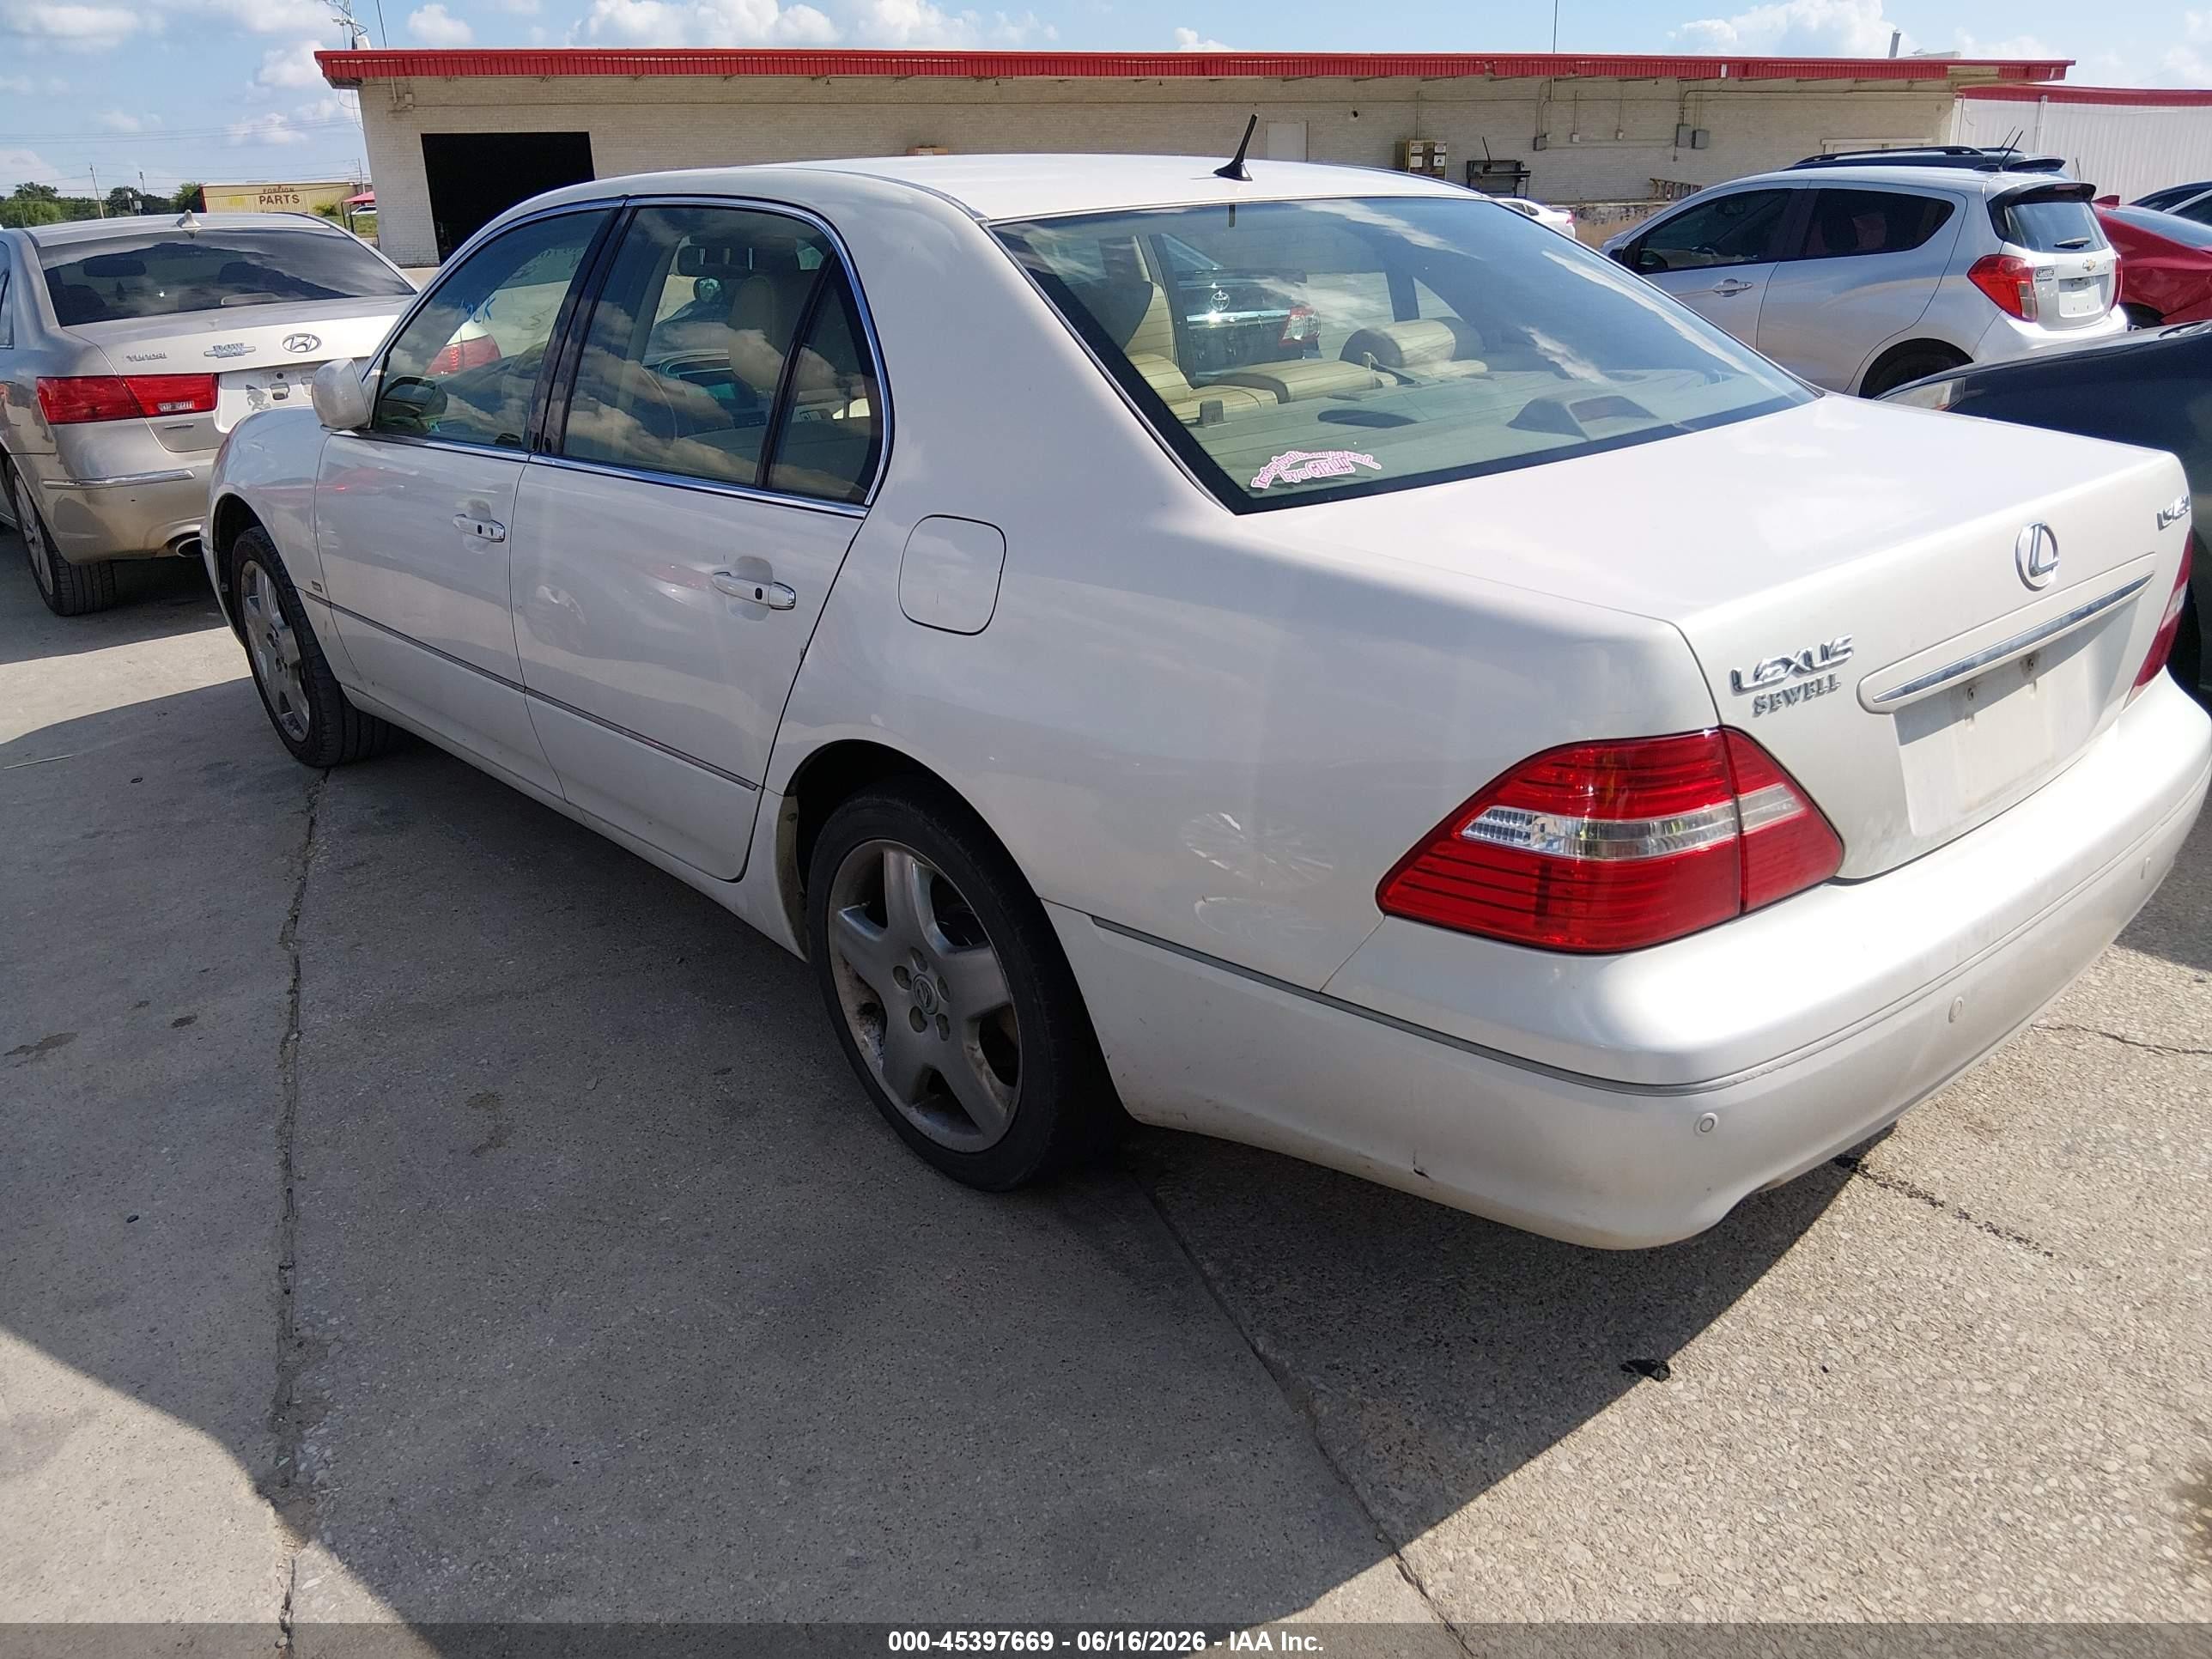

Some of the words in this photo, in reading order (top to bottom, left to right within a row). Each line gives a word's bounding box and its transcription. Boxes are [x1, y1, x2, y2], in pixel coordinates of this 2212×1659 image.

[259, 194, 300, 205] PARTS
[1280, 469, 1299, 481] by
[1308, 457, 1352, 476] GIRL!!!
[1729, 633, 1854, 696] LEXUS
[1753, 672, 1842, 717] SEWELL
